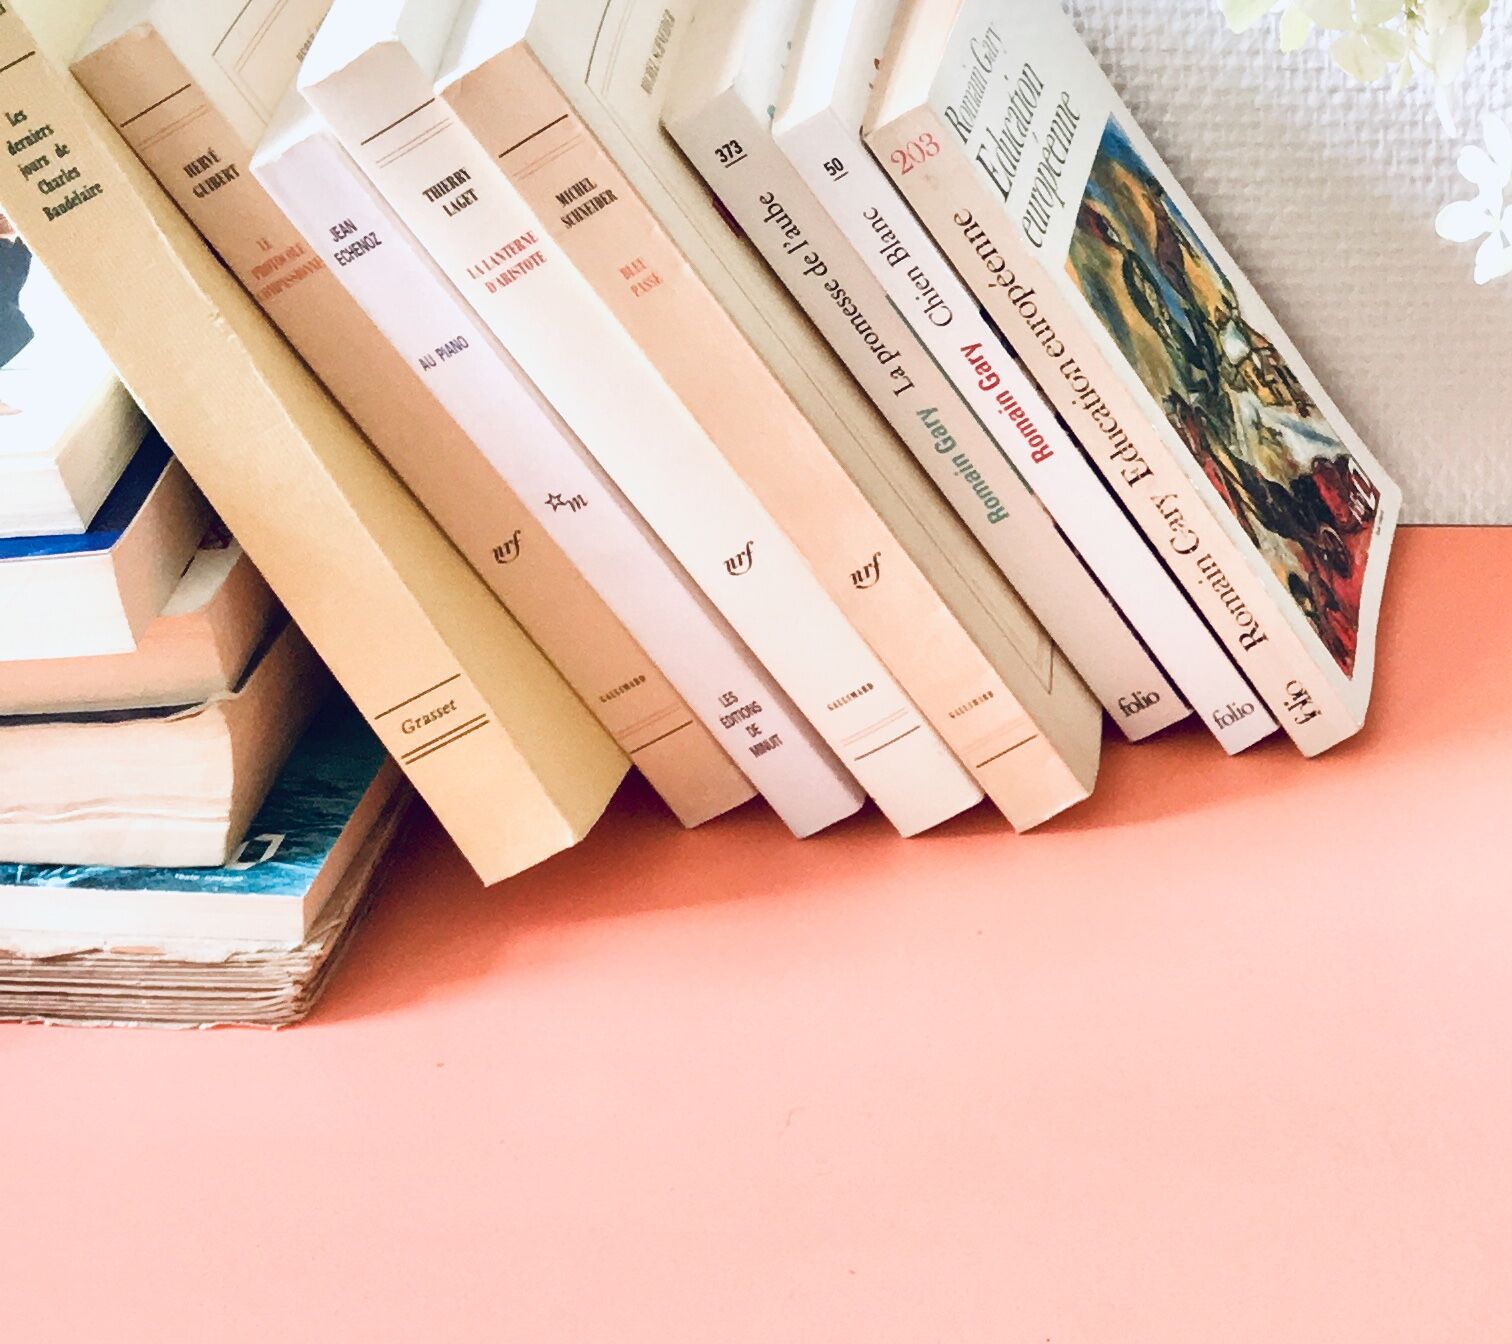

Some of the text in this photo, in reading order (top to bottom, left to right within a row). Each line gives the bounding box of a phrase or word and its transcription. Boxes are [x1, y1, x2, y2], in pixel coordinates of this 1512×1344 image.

[944, 26, 1008, 144] Romain Gary
[5, 110, 27, 127] Les
[975, 62, 1045, 203] Education
[7, 124, 54, 156] derniers
[714, 139, 744, 163] 373
[890, 132, 940, 175] 203
[18, 143, 71, 181] jours de
[183, 147, 222, 178] HERVÉ
[823, 157, 845, 177] 50
[1022, 90, 1081, 248] européenne
[37, 166, 81, 195] Charles
[192, 163, 240, 198] GUIBERT
[422, 167, 472, 203] THIERRY
[555, 177, 598, 208] MICHEL
[42, 182, 103, 222] Baudelaire
[442, 188, 479, 217] LAGET
[560, 189, 619, 229] SCHNEIDER
[329, 218, 358, 243] JEAN
[334, 231, 383, 267] ECHENOZ
[466, 230, 539, 280] LA LANTERNE
[863, 207, 954, 328] Chien Blanc
[759, 191, 915, 398] La promesse de l'aube
[418, 335, 470, 372] AU PIANO
[960, 341, 1055, 465] Romain Gary
[953, 207, 1269, 653] Romain Gary Education européenne
[915, 407, 1010, 526] Romain Gary
[492, 529, 521, 564] nrf
[723, 540, 754, 576] nrf
[849, 551, 881, 589] nrf
[401, 699, 457, 736] Grasset
[718, 691, 739, 708] LES
[1118, 691, 1160, 718] folio
[1212, 702, 1255, 730] folio
[745, 722, 762, 738] DE
[749, 733, 783, 758] MINUIT
